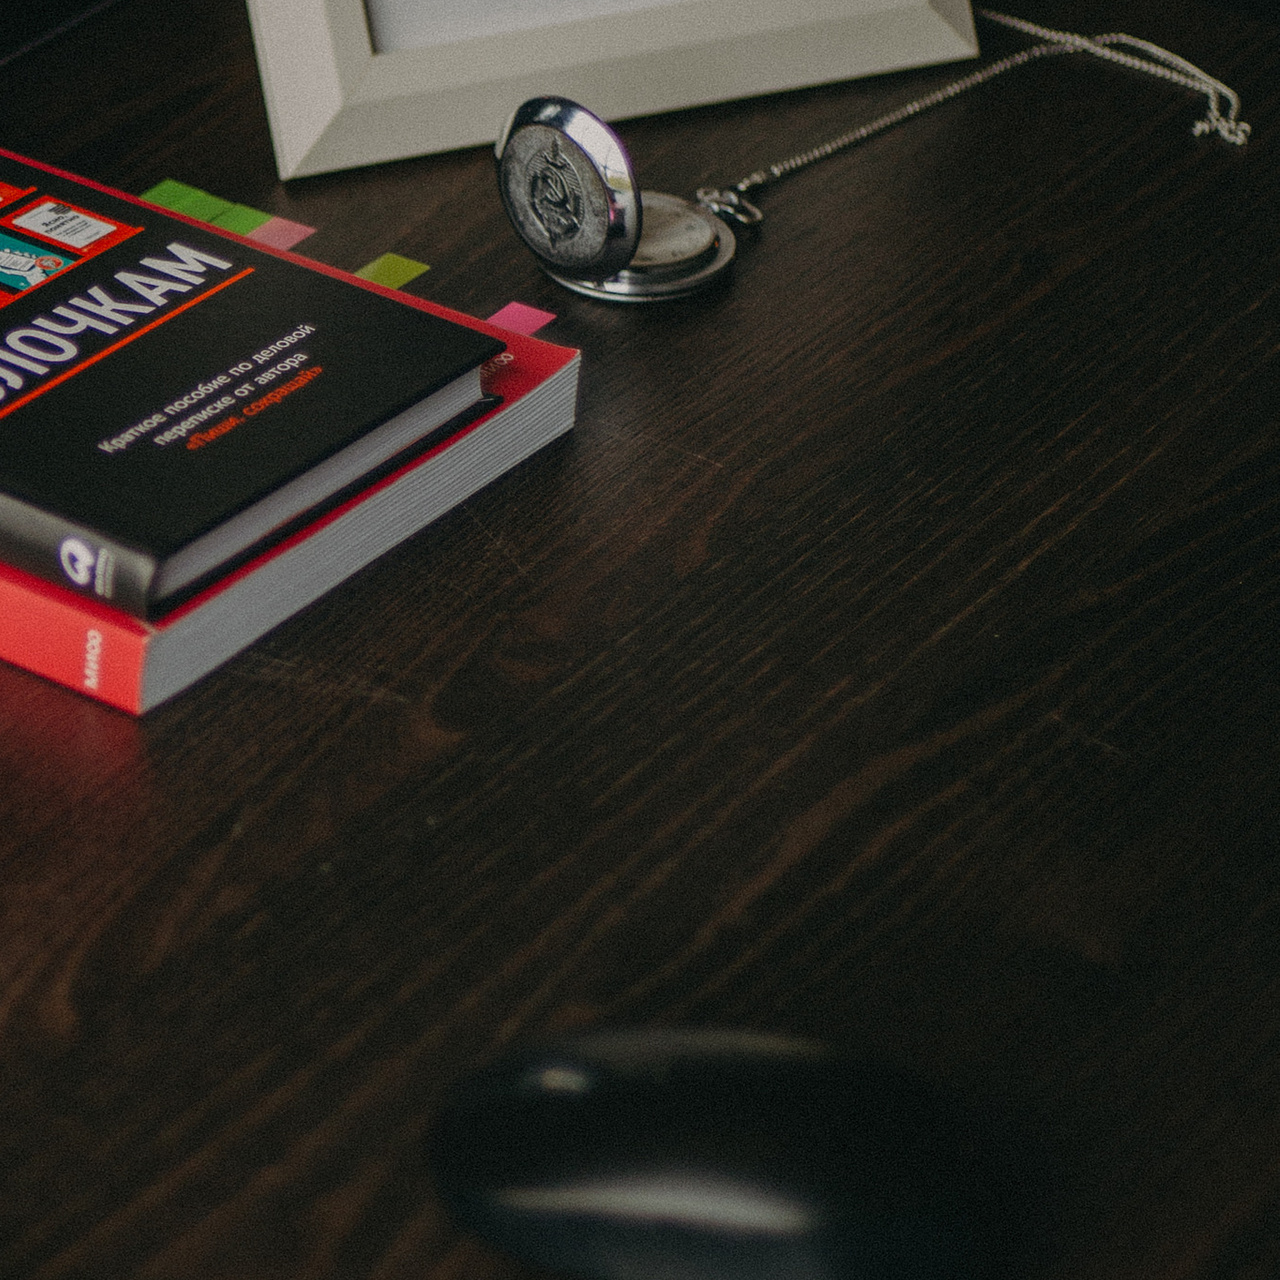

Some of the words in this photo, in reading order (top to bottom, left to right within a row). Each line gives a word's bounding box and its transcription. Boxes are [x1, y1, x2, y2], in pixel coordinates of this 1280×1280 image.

[97, 412, 168, 453] Краткое
[163, 374, 231, 415] пособие
[229, 361, 254, 377] по
[252, 324, 316, 364] деловой
[153, 394, 236, 446] переписке
[234, 382, 256, 397] от
[254, 351, 308, 385] автора
